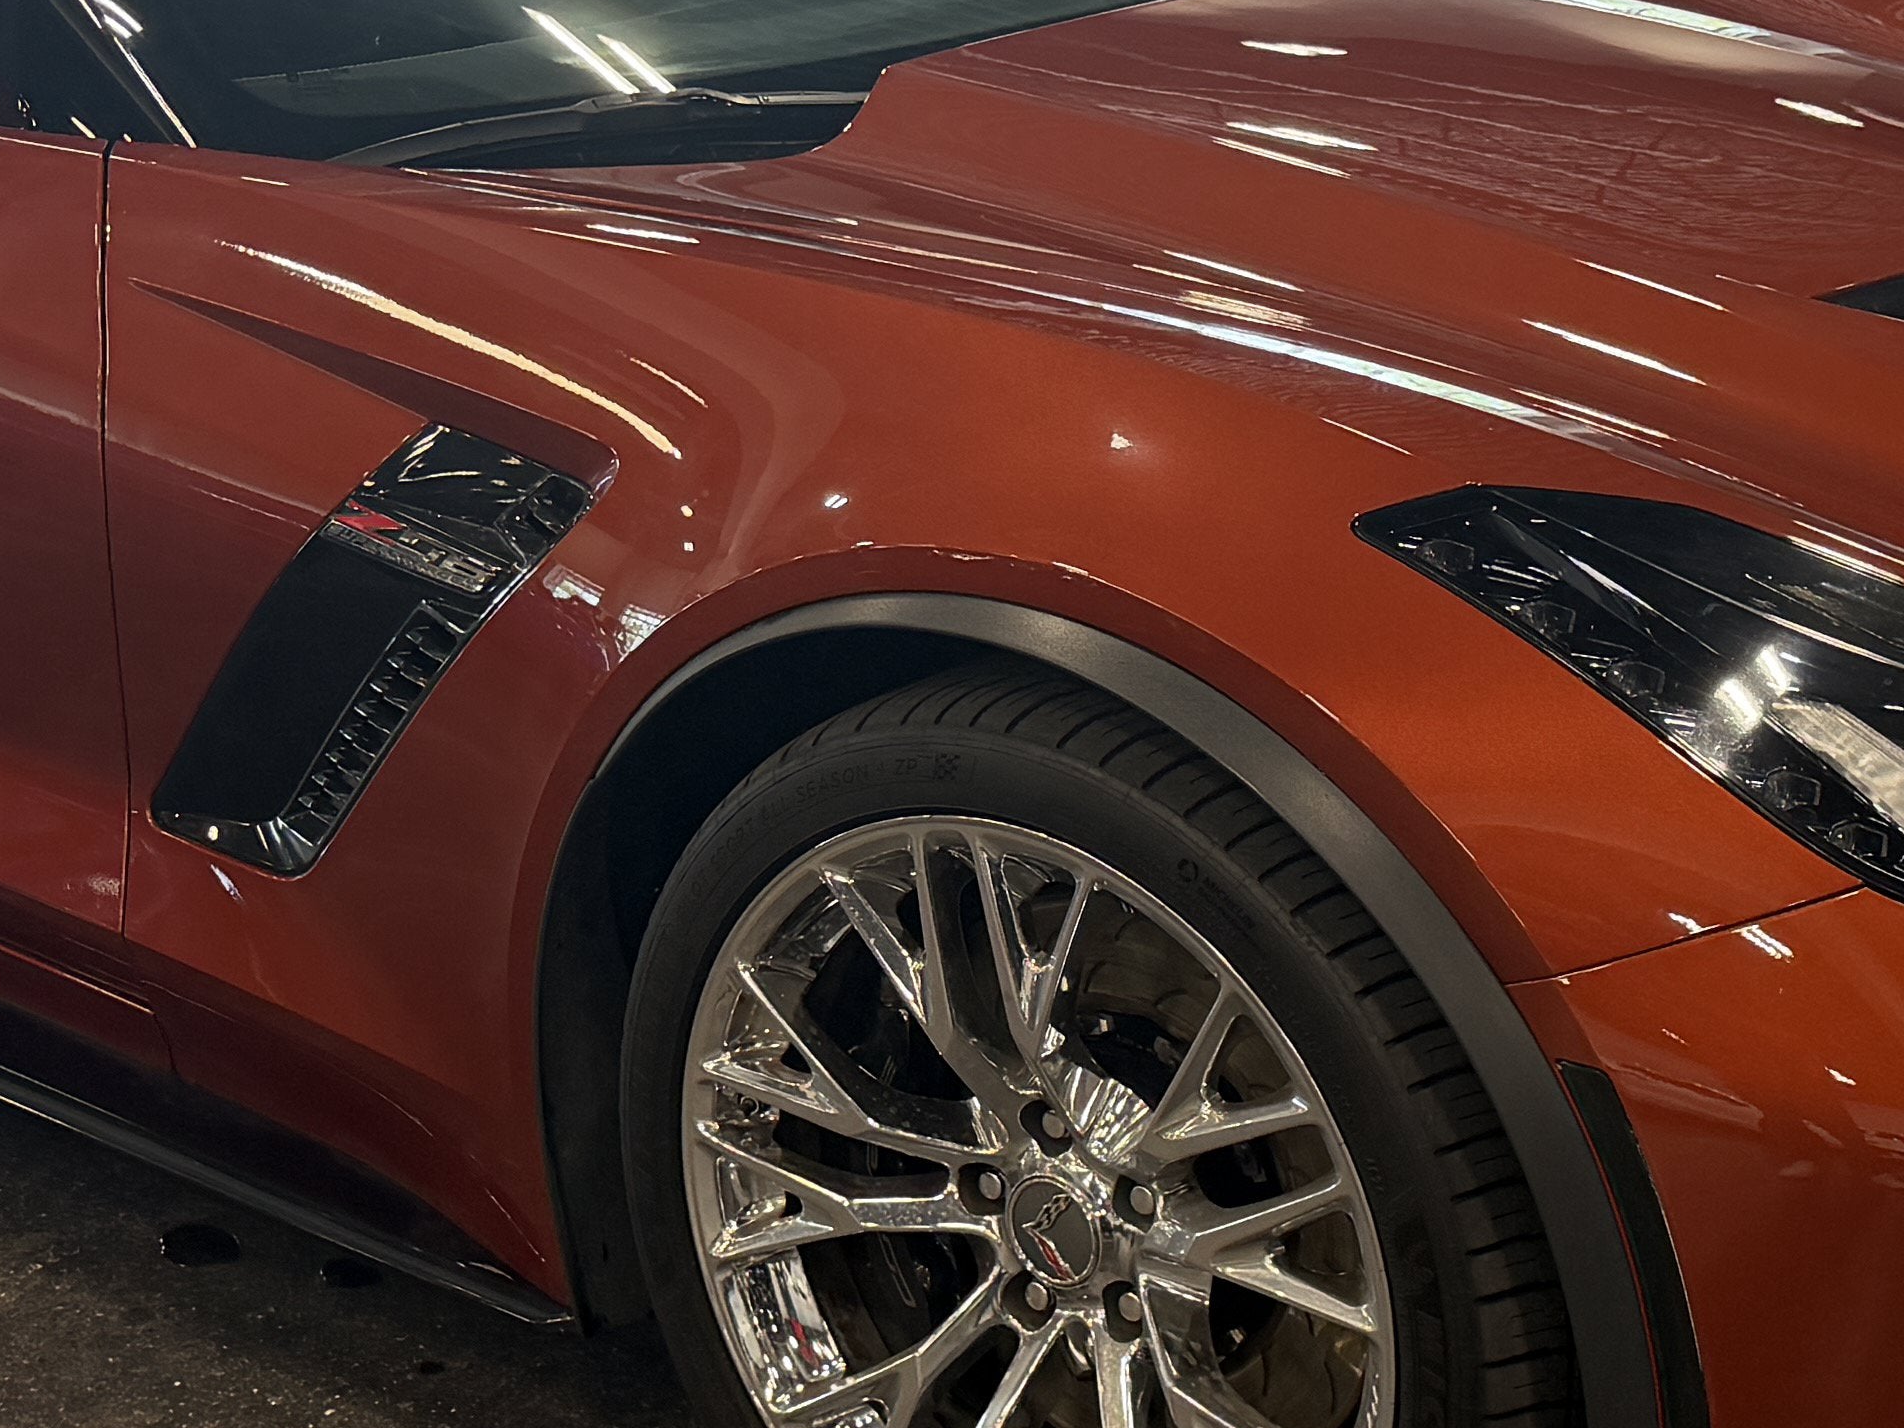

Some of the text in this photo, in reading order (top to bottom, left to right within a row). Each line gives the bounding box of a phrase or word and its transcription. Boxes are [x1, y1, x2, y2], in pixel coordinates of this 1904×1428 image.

[334, 500, 502, 583] Z06
[795, 764, 870, 804] SEASON
[894, 759, 918, 775] ZP
